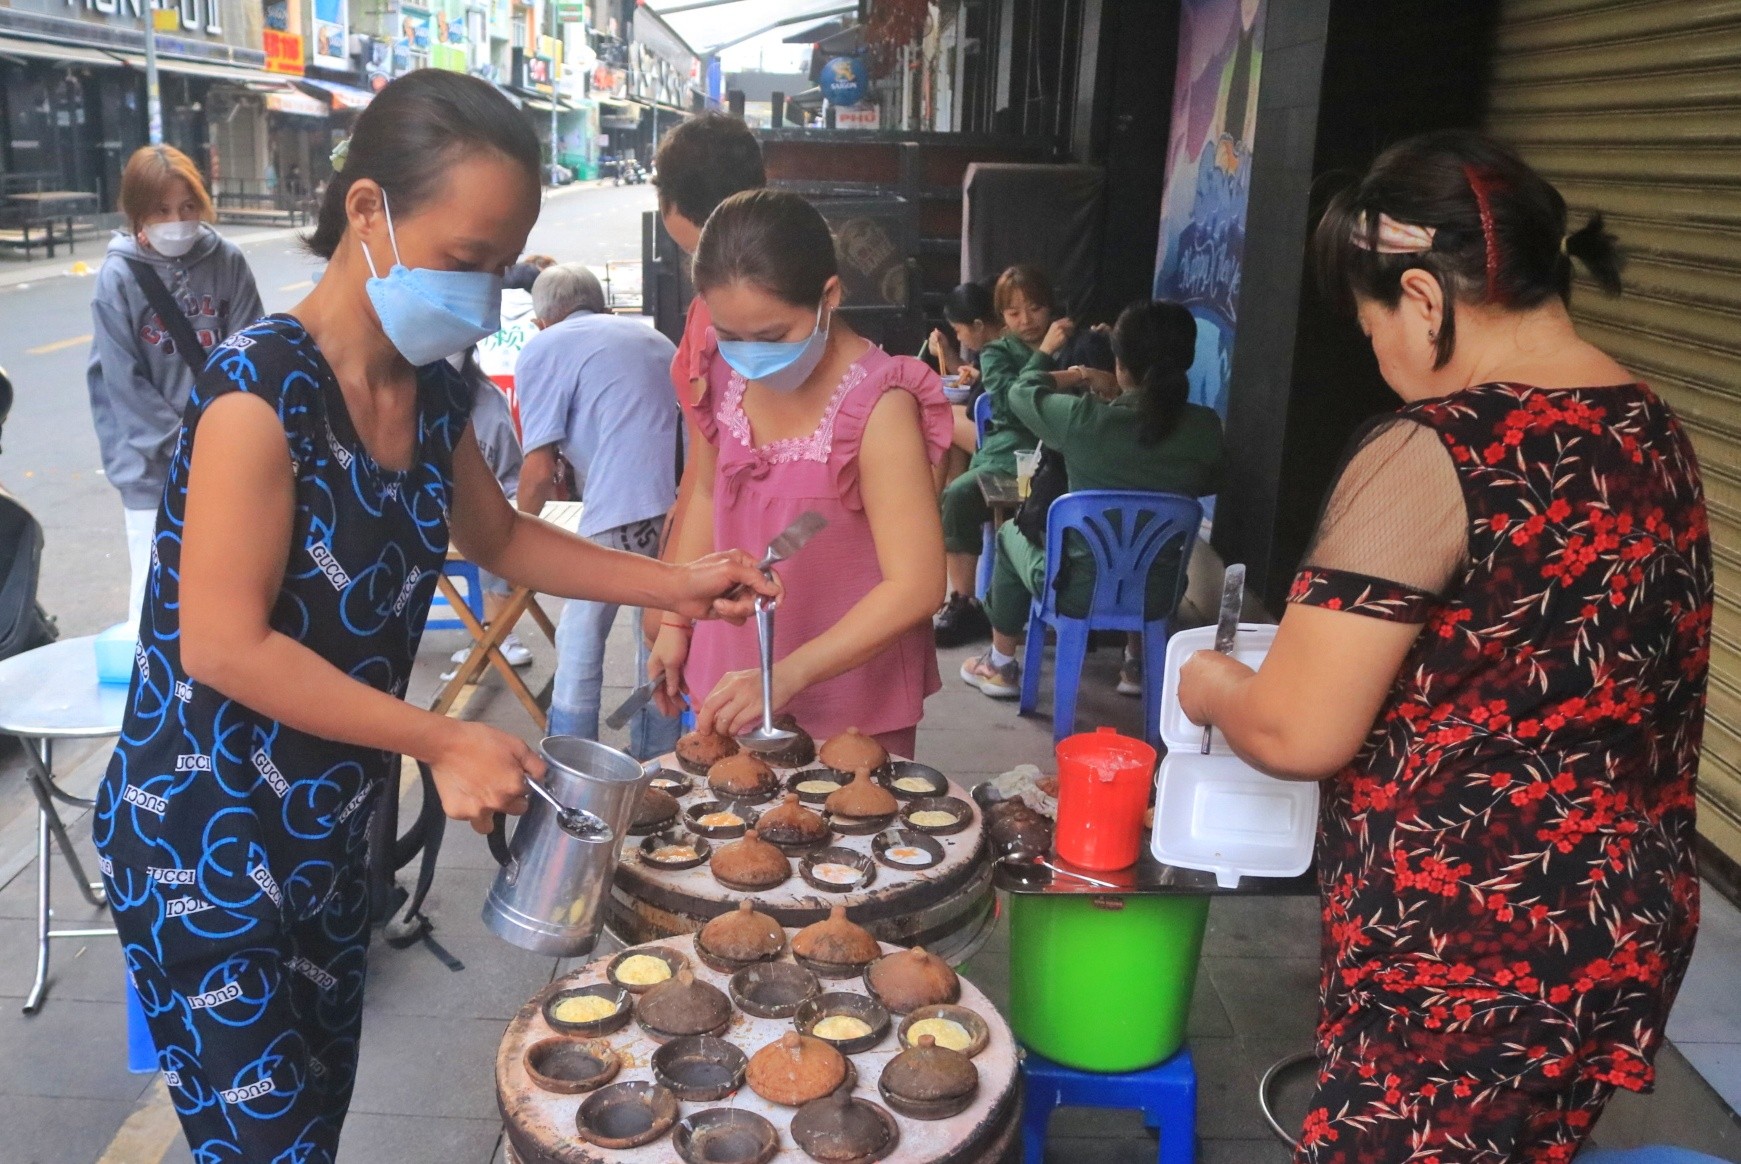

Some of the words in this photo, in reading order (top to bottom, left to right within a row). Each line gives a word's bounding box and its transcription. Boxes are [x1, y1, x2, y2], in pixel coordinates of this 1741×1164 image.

[311, 544, 350, 591] GUCCI
[253, 753, 290, 796] GUCCI
[125, 786, 167, 814] GUCCI
[189, 984, 239, 1008] GUCCI
[223, 1078, 273, 1103] GUCCI
